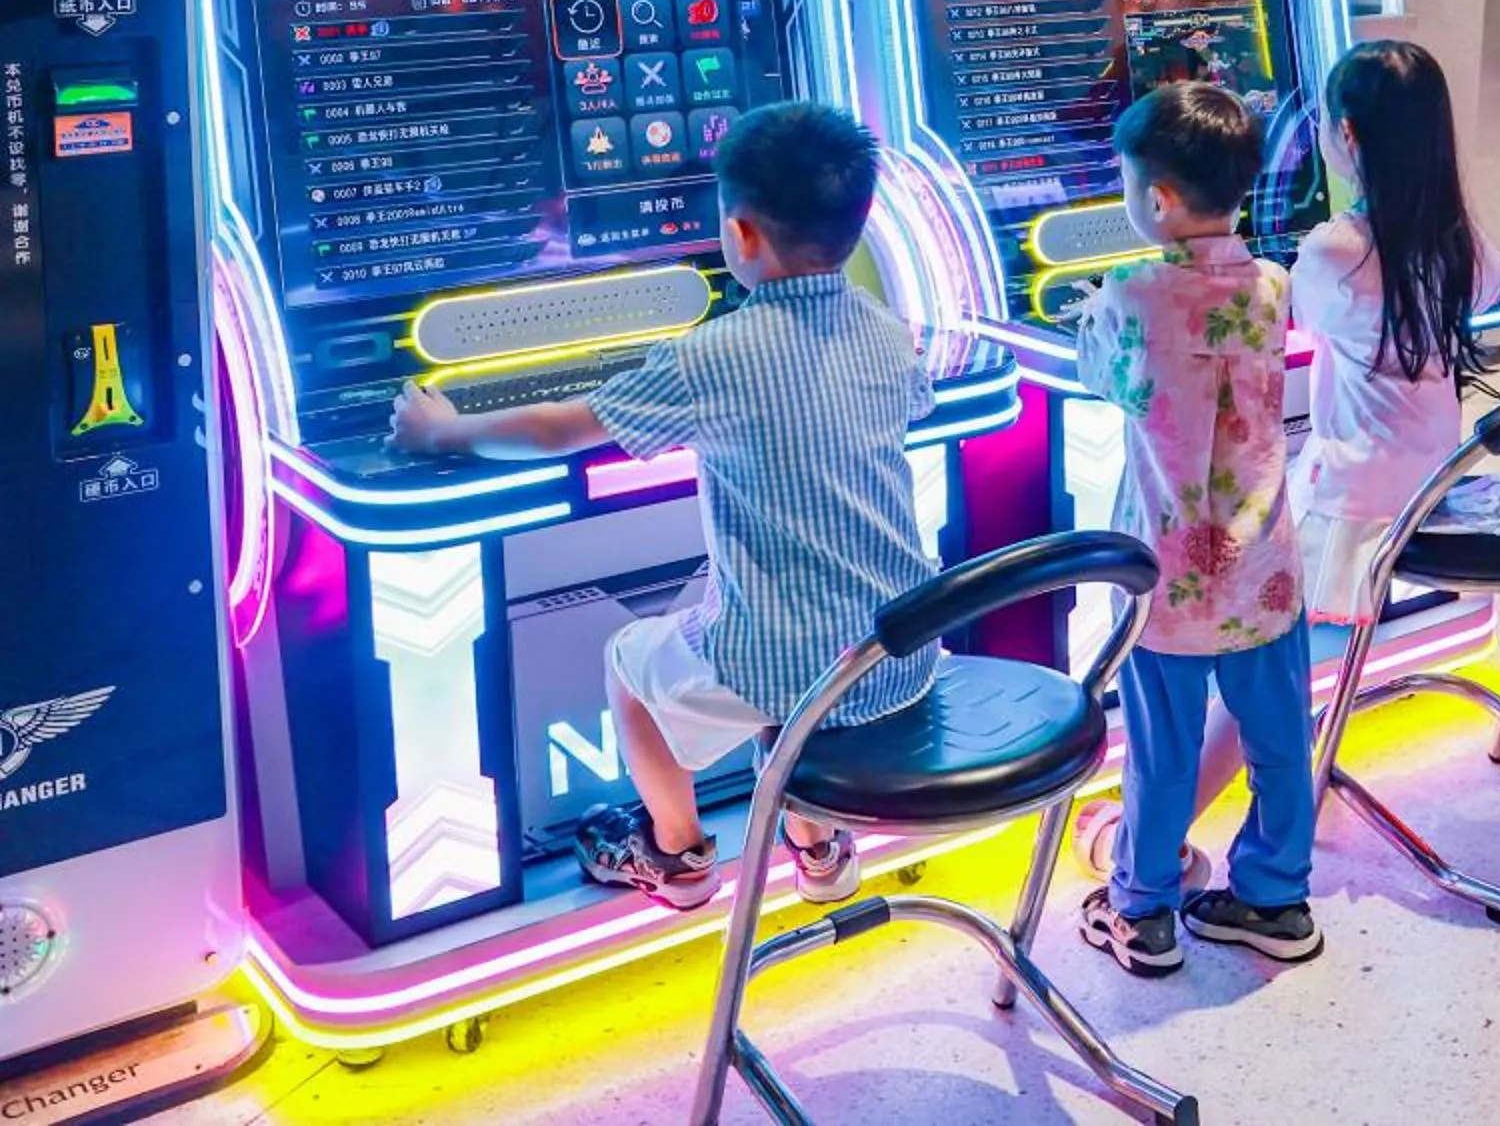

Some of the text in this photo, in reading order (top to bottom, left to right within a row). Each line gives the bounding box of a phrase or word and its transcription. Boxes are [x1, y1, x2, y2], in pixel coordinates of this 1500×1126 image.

[640, 196, 685, 214] 请投币
[85, 474, 155, 497] 硬币入口
[0, 773, 86, 811] ANGER
[1, 1062, 139, 1119] Changer
